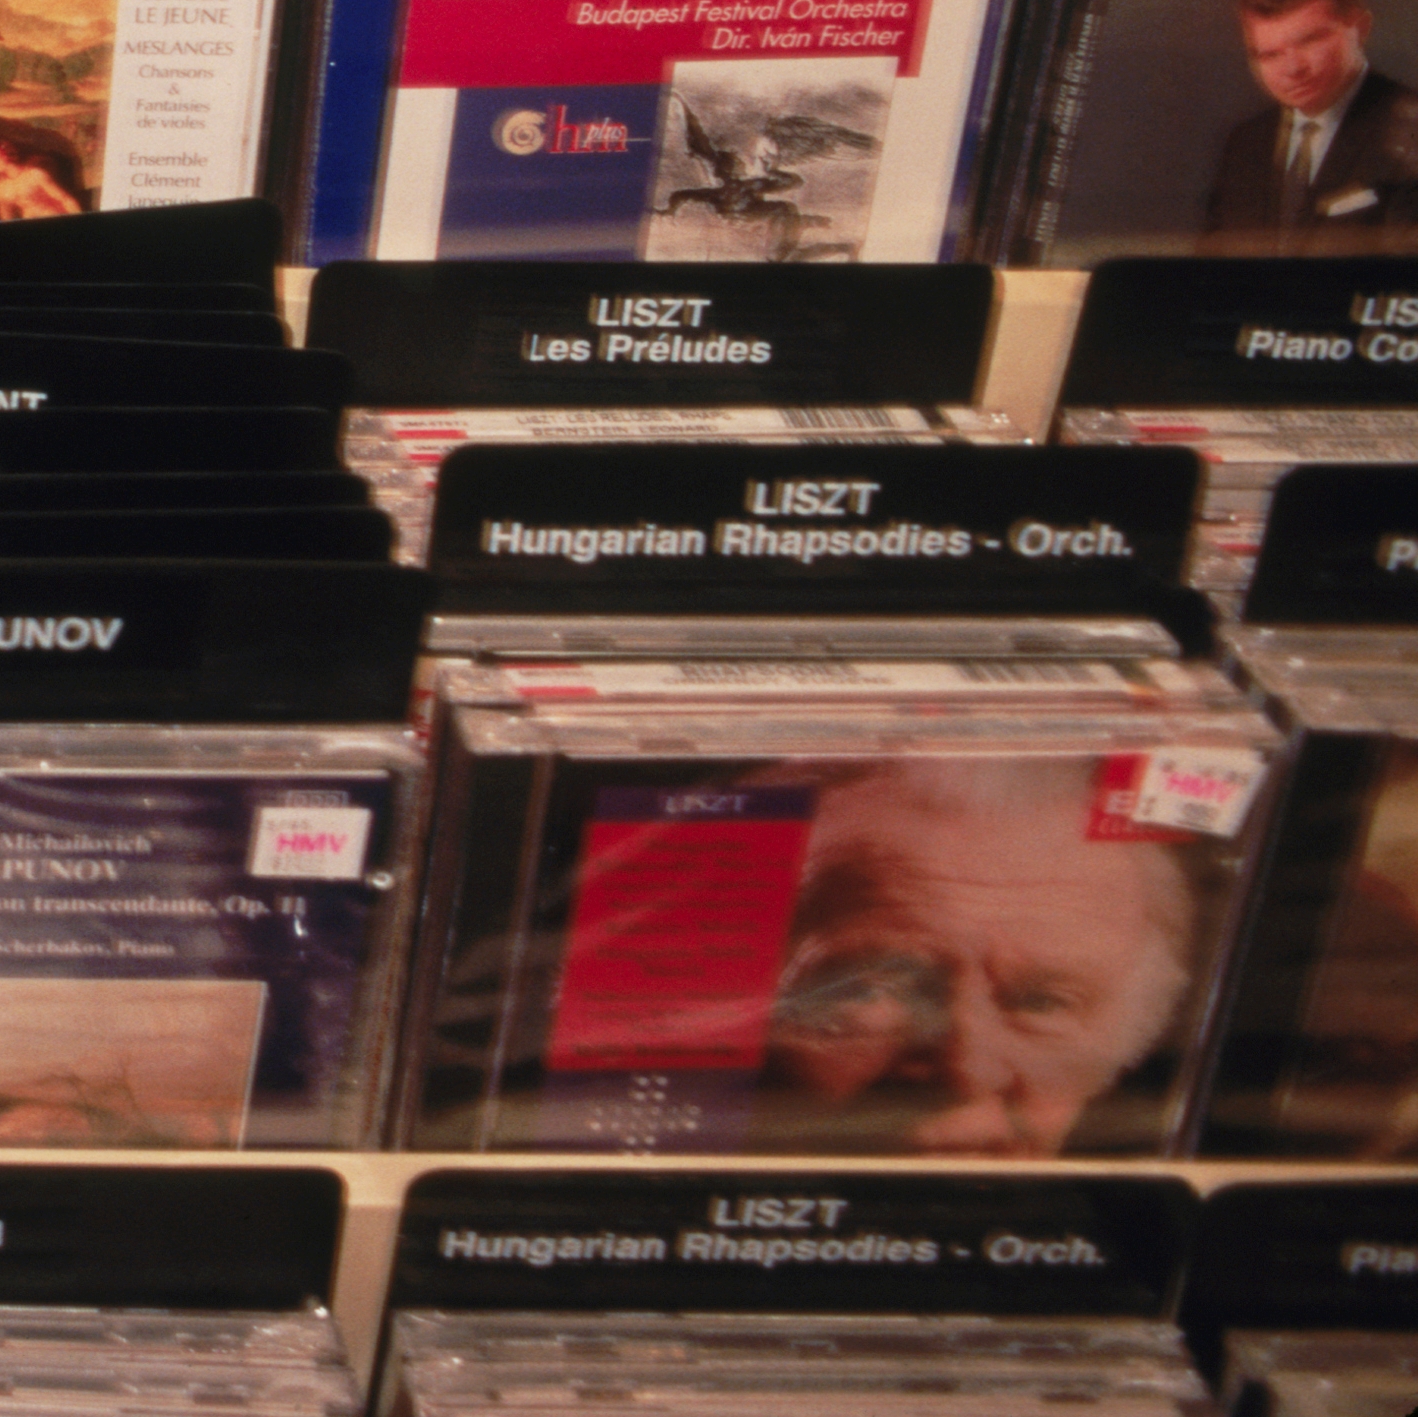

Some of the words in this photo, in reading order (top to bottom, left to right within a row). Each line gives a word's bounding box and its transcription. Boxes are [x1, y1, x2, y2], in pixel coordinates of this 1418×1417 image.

[135, 7, 157, 24] LE
[163, 7, 228, 25] JEUNE
[576, 0, 689, 30] Budapest
[695, 0, 781, 23] Festival
[124, 41, 234, 56] MESLANGES
[712, 27, 751, 49] Dir.
[761, 27, 811, 48] Iván
[819, 25, 902, 48] Fischer
[598, 299, 711, 327] LISZT
[529, 334, 590, 362] Les
[607, 334, 770, 364] Préludes
[1247, 331, 1352, 360] Piano
[752, 483, 879, 515] LISZT
[487, 524, 705, 564] Hungarian
[718, 524, 971, 564] Rhapsodies
[1013, 524, 1132, 558] Orch.
[713, 1198, 848, 1229] LISZT
[442, 1231, 666, 1266] Hungarian
[678, 1232, 939, 1266] Rhapsodies
[987, 1234, 1106, 1266] Orch.
